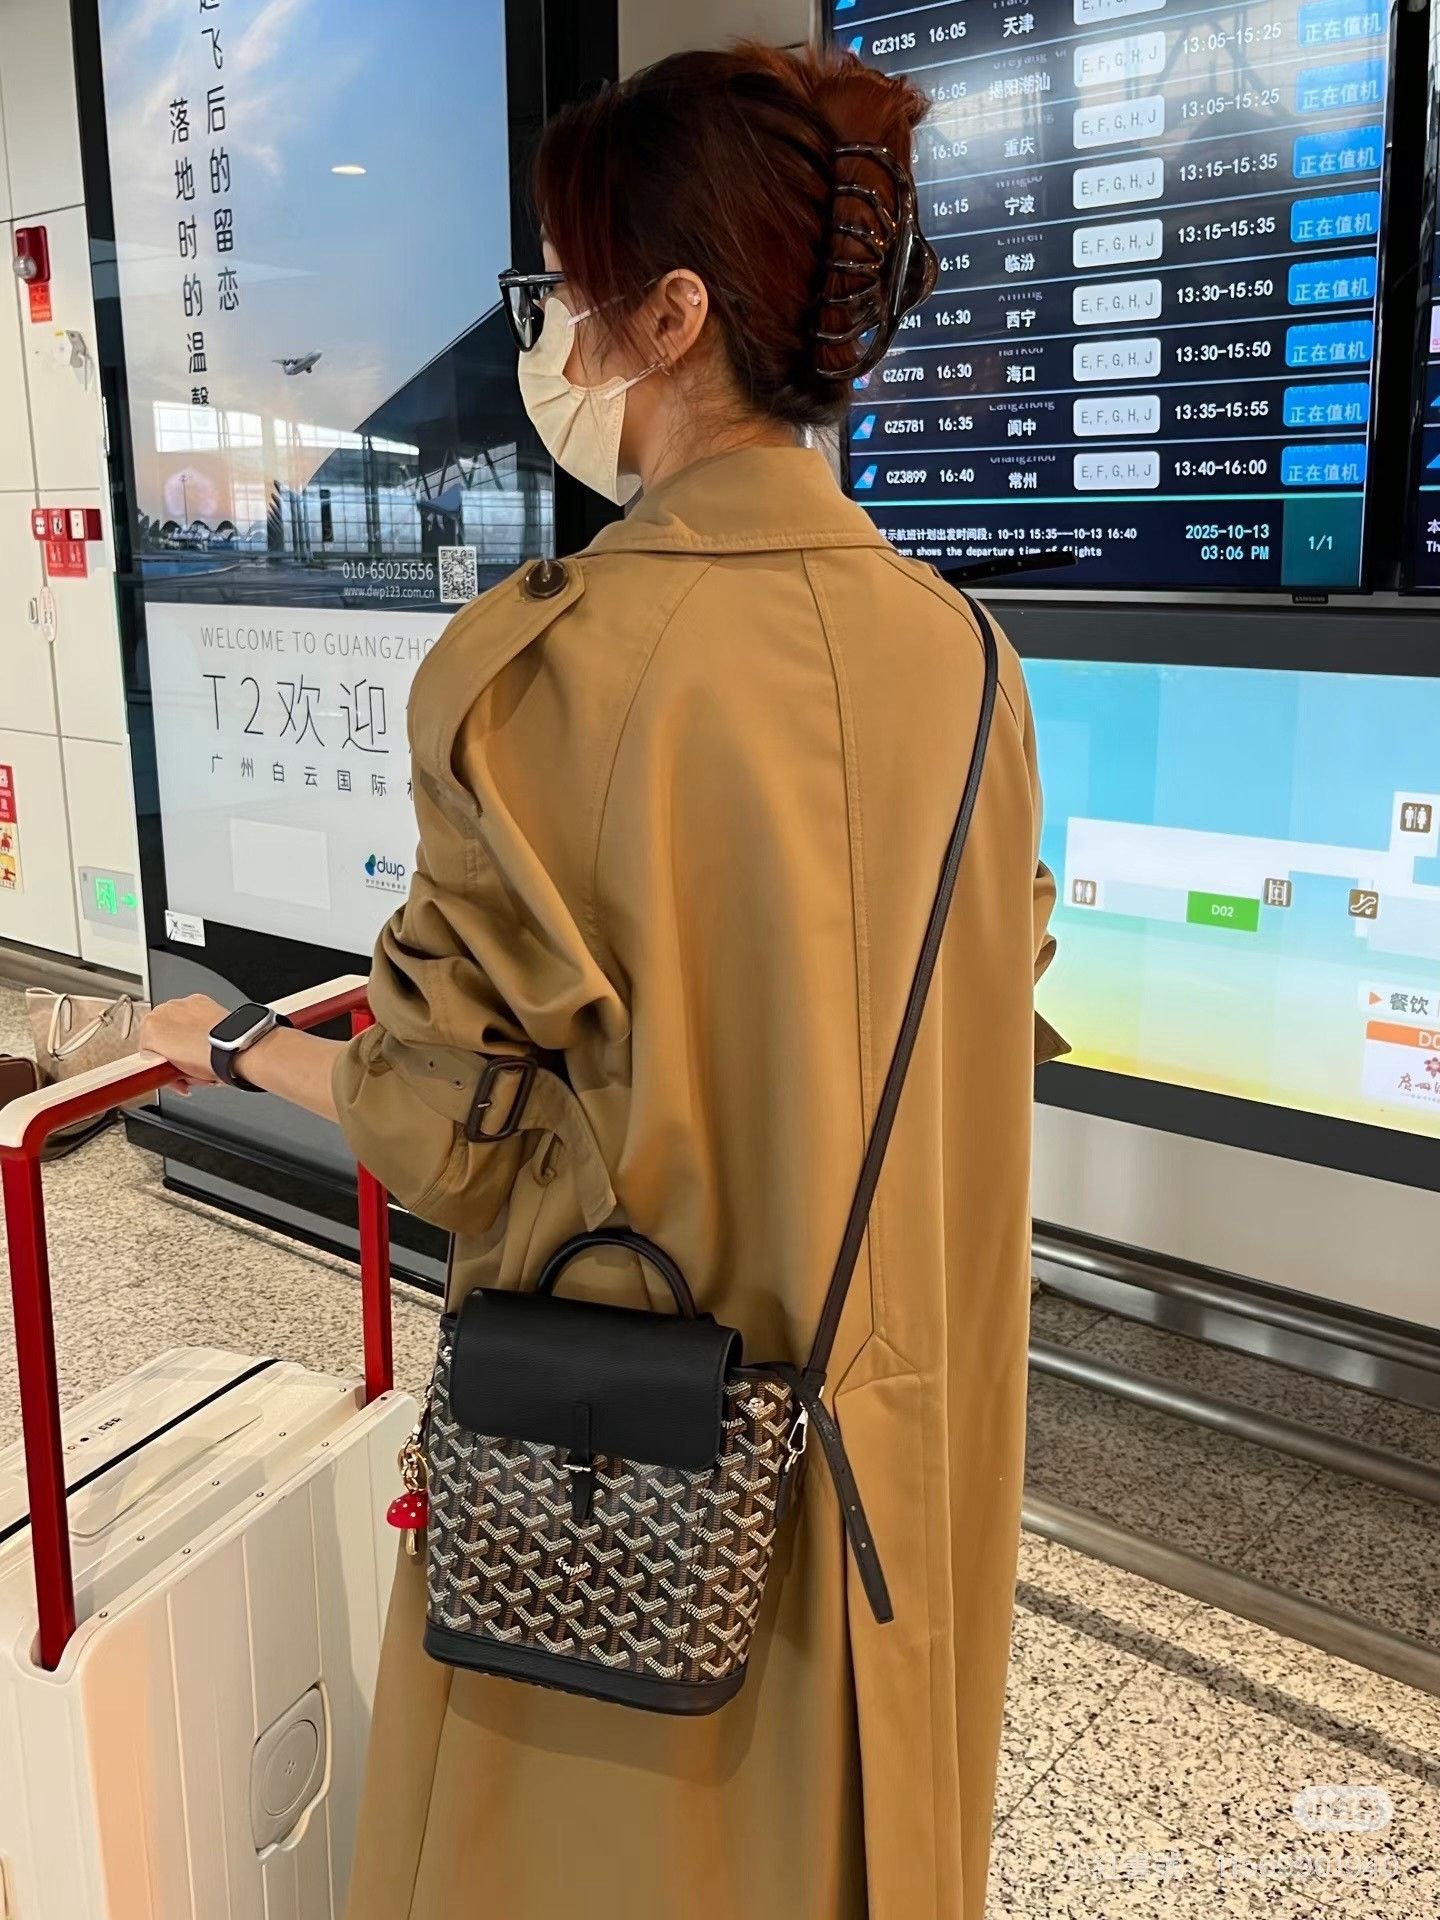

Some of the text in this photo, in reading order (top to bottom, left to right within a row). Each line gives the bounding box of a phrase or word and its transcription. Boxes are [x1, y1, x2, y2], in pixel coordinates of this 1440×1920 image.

[1002, 13, 1034, 38] 天津
[1304, 12, 1382, 43] 正在值机
[872, 21, 967, 55] CZ3135 16:05
[1182, 22, 1282, 54] 13:05-15:25
[1303, 79, 1378, 109] 正在值机
[1181, 89, 1280, 119] 13:05-15:25
[932, 142, 968, 160] 16:05
[1003, 136, 1035, 158] 重庆
[1179, 153, 1278, 182] 13:15-15:35
[1300, 147, 1376, 176] 正在值机
[933, 199, 969, 217] 16:15
[1005, 194, 1035, 216] 宁波
[1178, 217, 1276, 244] 13:15-15:35
[1297, 213, 1373, 239] 正在值机
[940, 255, 970, 272] 6:15
[1004, 253, 1035, 273] 临汾
[1177, 279, 1274, 304] 13:30-15:50
[1295, 278, 1369, 302] 正在值机
[935, 310, 971, 326] 16:30
[1006, 309, 1036, 328] 西宁
[1176, 341, 1271, 363] 13:30-15:50
[1293, 341, 1367, 363] 正在值机
[883, 364, 972, 383] CZ6778 16:30
[1006, 365, 1036, 383] 海口
[1175, 401, 1269, 420] 13:35-15:55
[1290, 402, 1363, 424] 正在值机
[884, 416, 974, 434] CZ5781 16:35
[1007, 418, 1037, 437] 阆中
[886, 468, 975, 484] CZ3899 16:40
[1174, 459, 1267, 477] 13:40-16:00
[1288, 463, 1360, 482] 正在值机
[1008, 471, 1037, 489] 常州
[1108, 528, 1137, 540] 16:40
[1185, 524, 1270, 539] 2025-10-13
[916, 547, 942, 556] shows
[946, 547, 963, 556] the
[966, 547, 1015, 557] departure
[1201, 545, 1270, 560] 03:06 PM
[1308, 535, 1333, 551] 1/1
[342, 562, 434, 580] 010-65025656
[343, 585, 435, 599] www.dwp123.com.cn
[201, 627, 285, 652] WELCOME
[292, 631, 317, 654] TO
[377, 856, 406, 881] dwp
[1211, 903, 1235, 919] D02
[1390, 993, 1429, 1015] 餐饮
